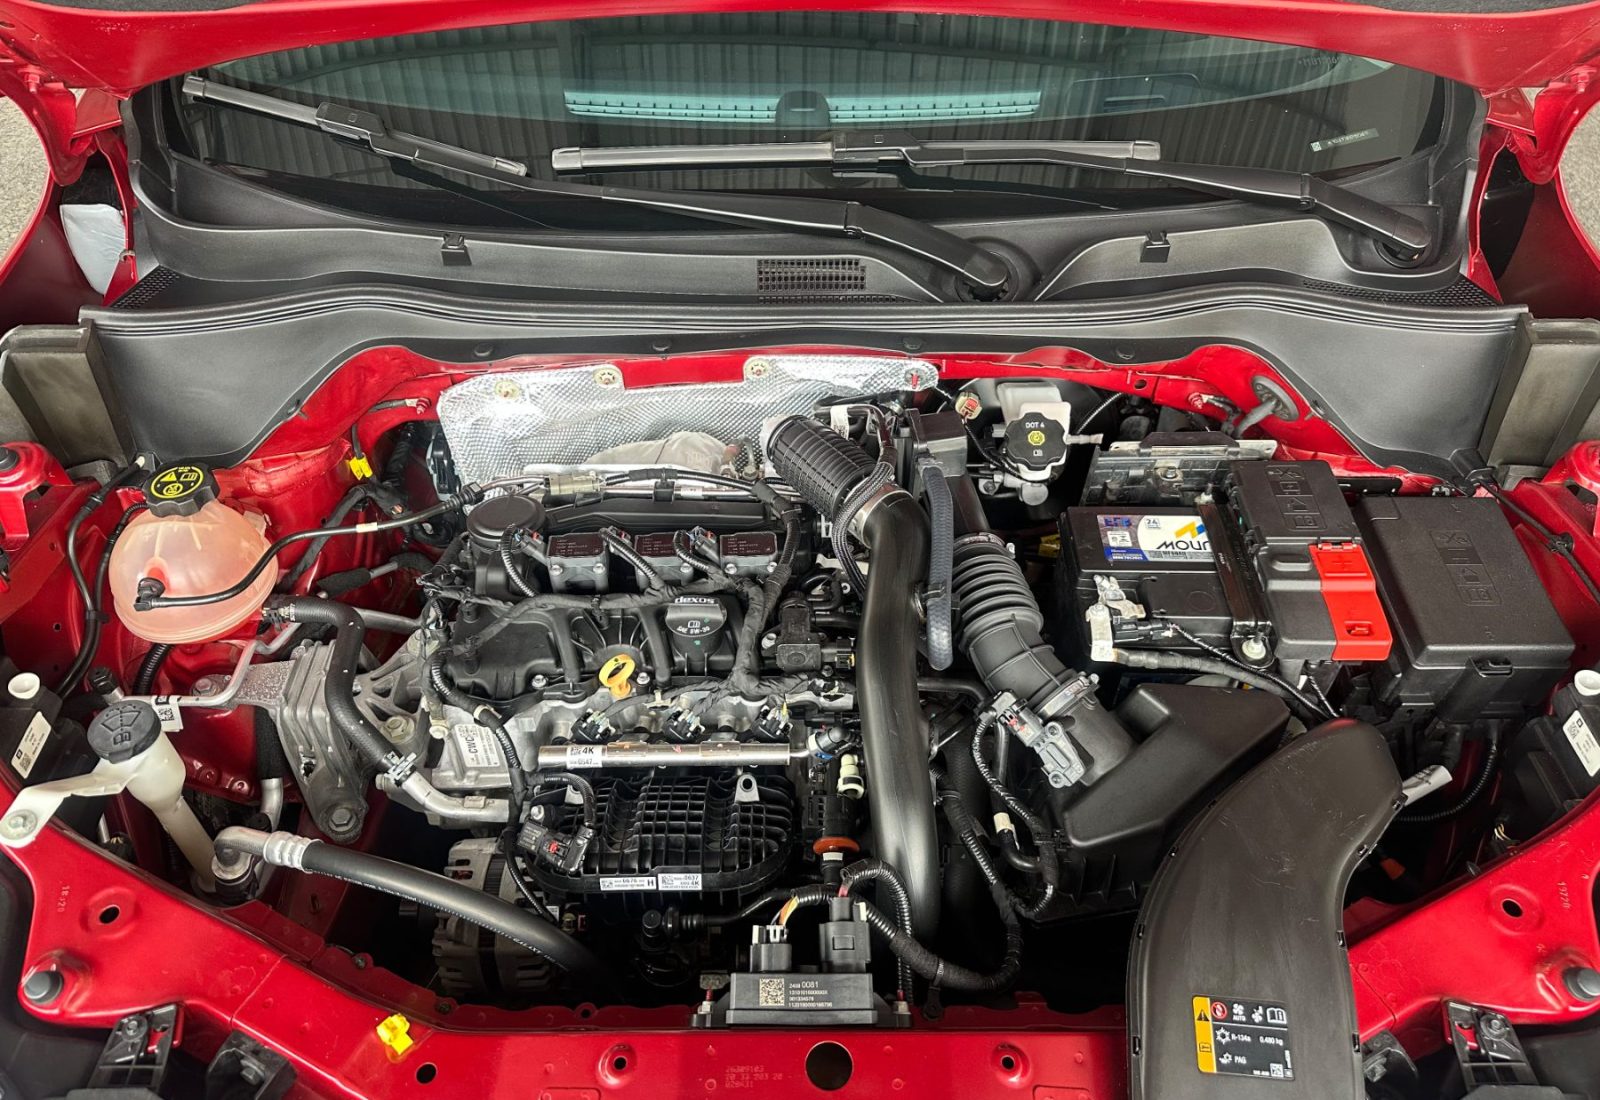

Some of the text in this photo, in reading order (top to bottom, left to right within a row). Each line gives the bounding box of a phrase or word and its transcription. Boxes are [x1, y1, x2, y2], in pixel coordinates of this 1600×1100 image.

[582, 746, 594, 754] 4K
[647, 879, 655, 887] H
[1234, 1055, 1247, 1064] PAG
